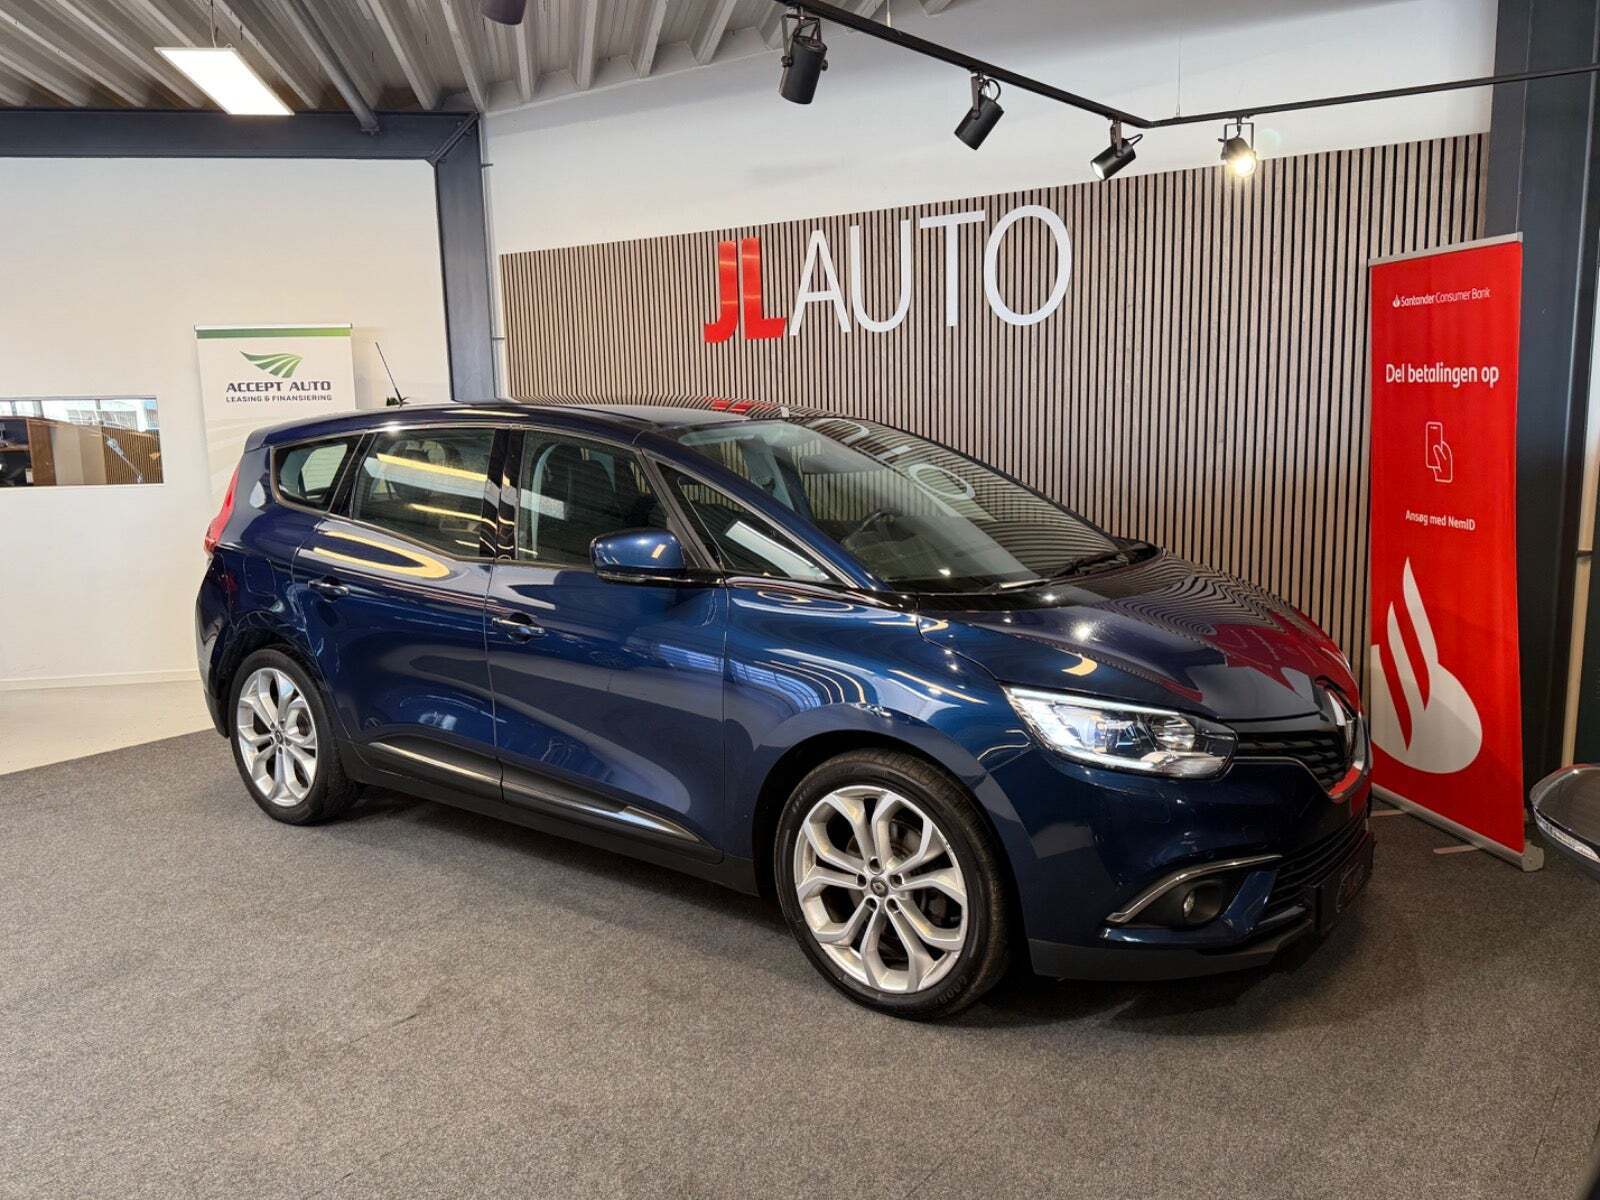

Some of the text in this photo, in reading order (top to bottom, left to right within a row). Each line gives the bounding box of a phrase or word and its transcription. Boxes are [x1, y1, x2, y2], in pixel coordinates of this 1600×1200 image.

[704, 204, 1072, 343] JL AUTO
[1400, 287, 1491, 307] Santander Consumer Bank
[1386, 362, 1500, 388] Del betalingen op
[226, 380, 332, 392] ACCEPT AUTO
[225, 395, 263, 403] LEASING
[271, 394, 332, 402] FINANSIERING
[1405, 510, 1475, 531] Ansøg med NemID
